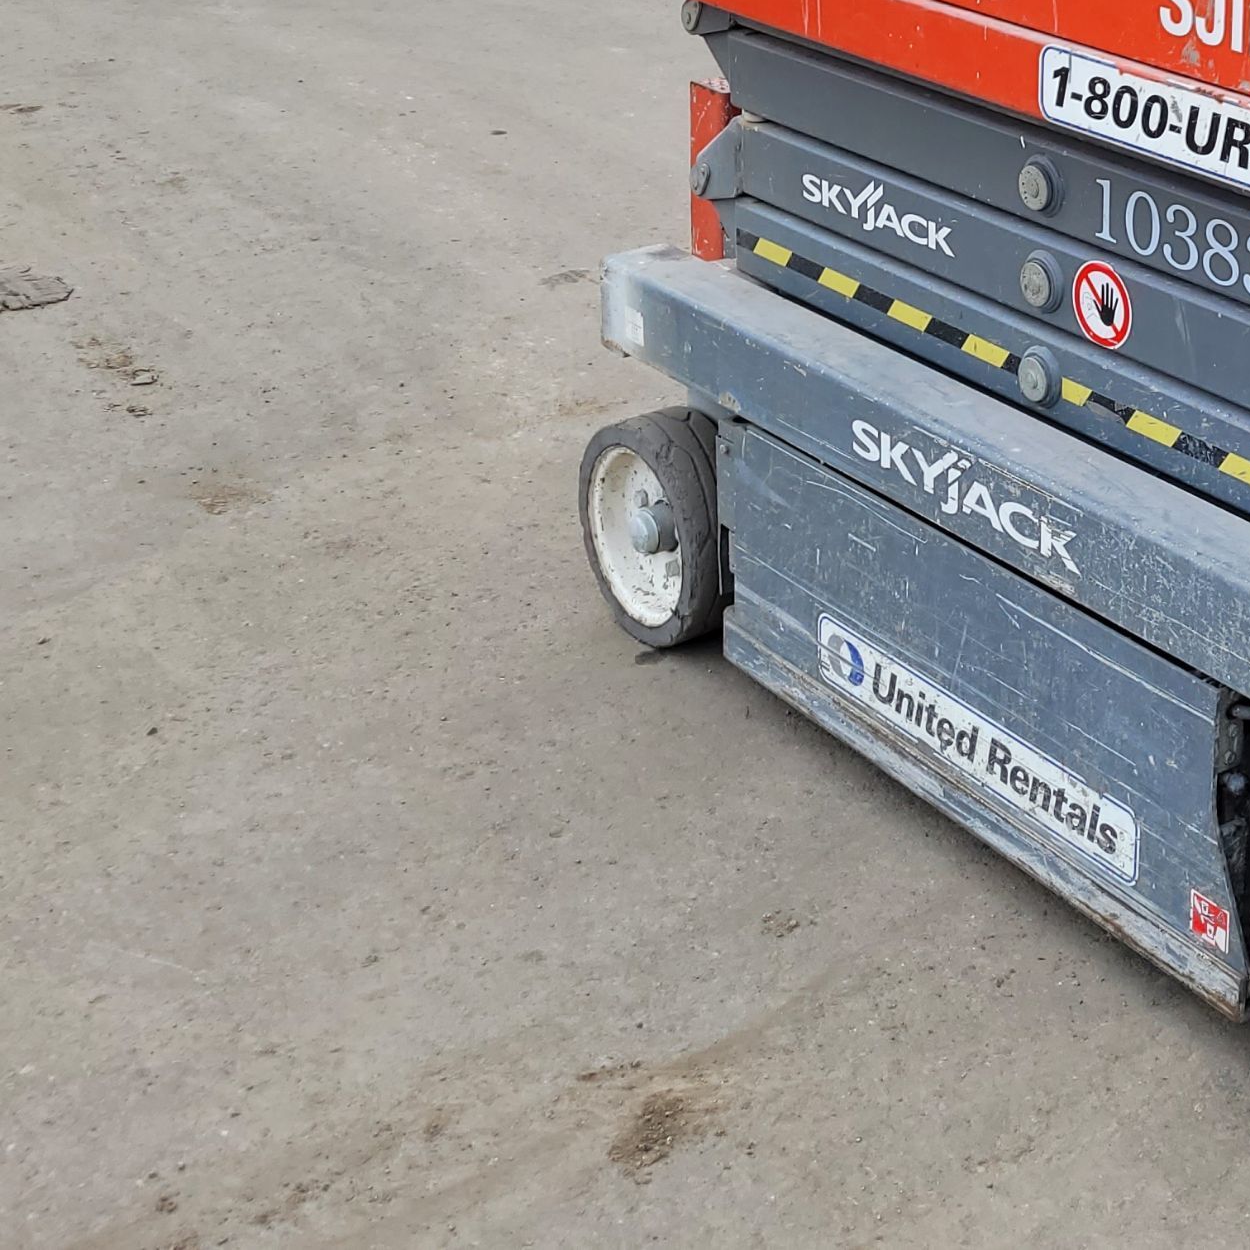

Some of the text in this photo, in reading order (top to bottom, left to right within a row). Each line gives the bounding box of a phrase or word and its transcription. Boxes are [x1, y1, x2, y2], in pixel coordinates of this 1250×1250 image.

[802, 173, 955, 258] SKYJACK
[851, 419, 1081, 577] SKYJACK
[872, 663, 1118, 855] United Rentals
